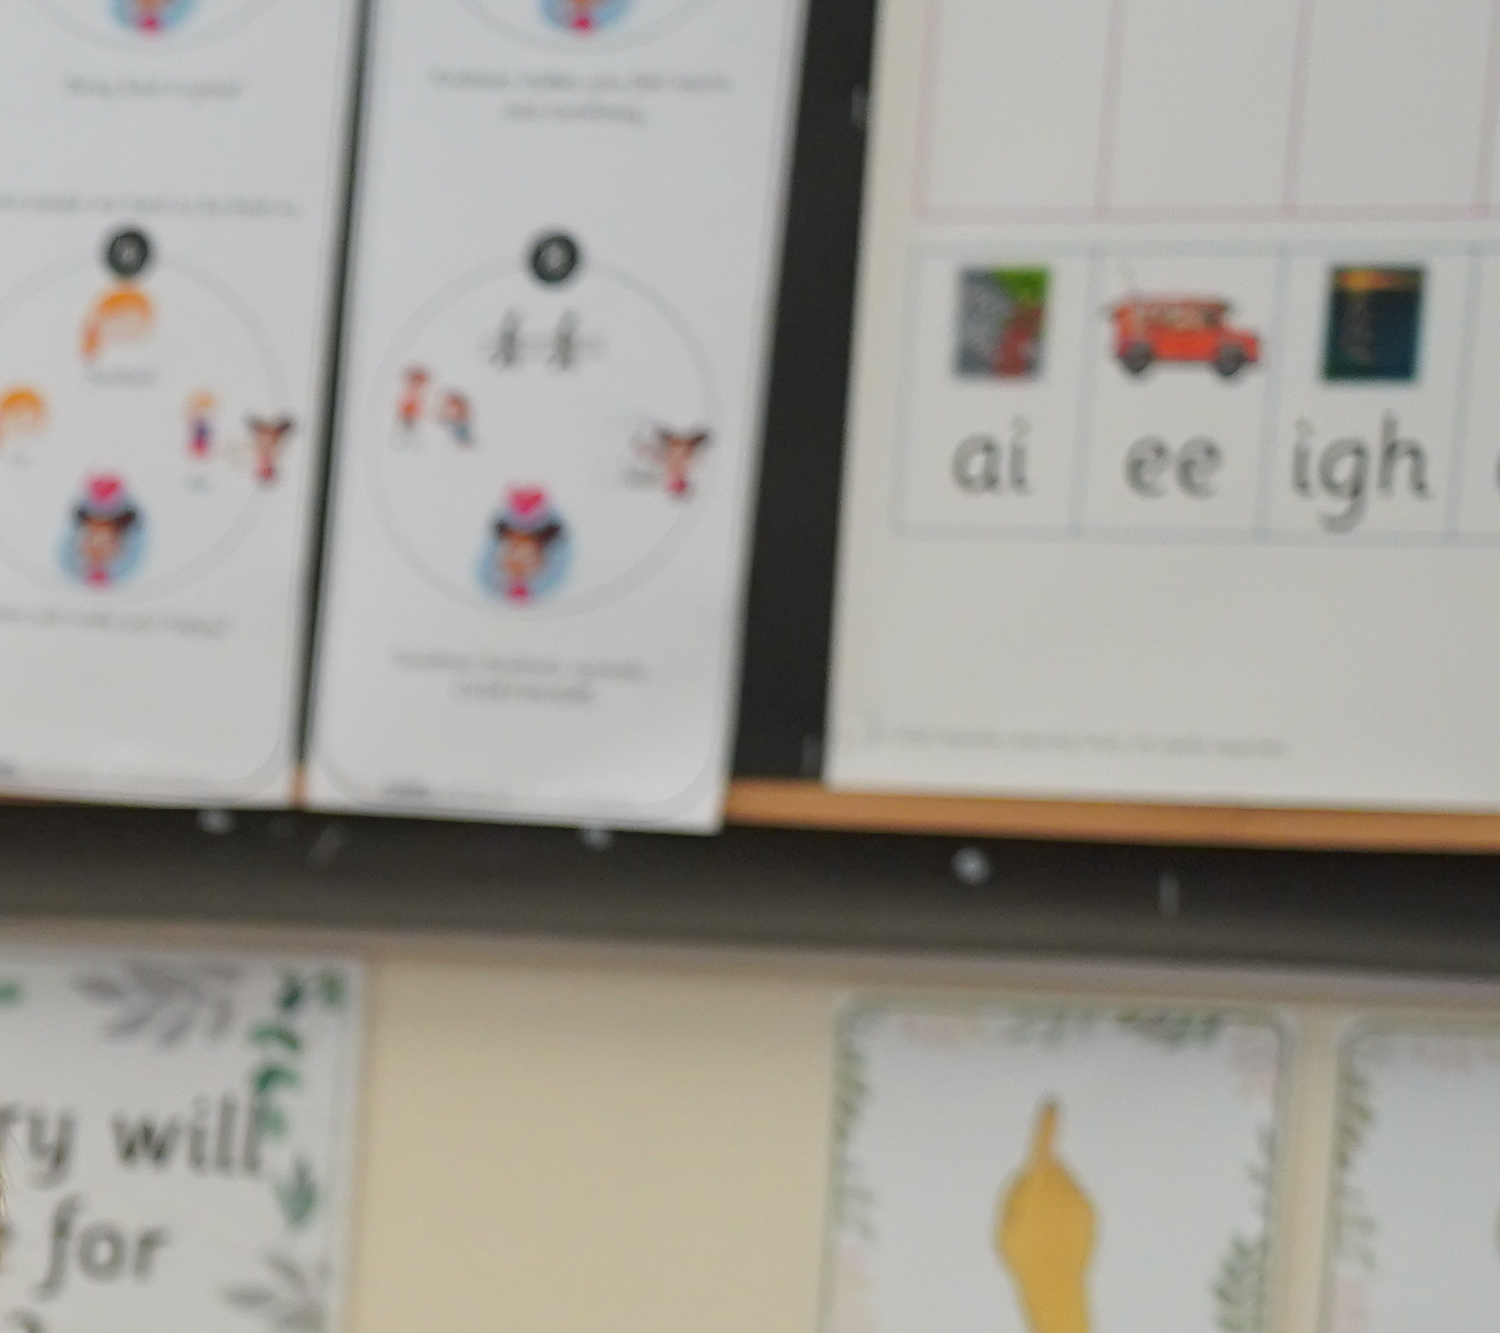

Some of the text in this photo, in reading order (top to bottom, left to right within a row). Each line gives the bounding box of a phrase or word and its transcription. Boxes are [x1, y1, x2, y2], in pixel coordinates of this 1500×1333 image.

[951, 420, 1032, 498] ai
[1124, 434, 1224, 500] ee
[1292, 411, 1434, 534] igh
[111, 1094, 266, 1178] will
[34, 1195, 170, 1302] for
